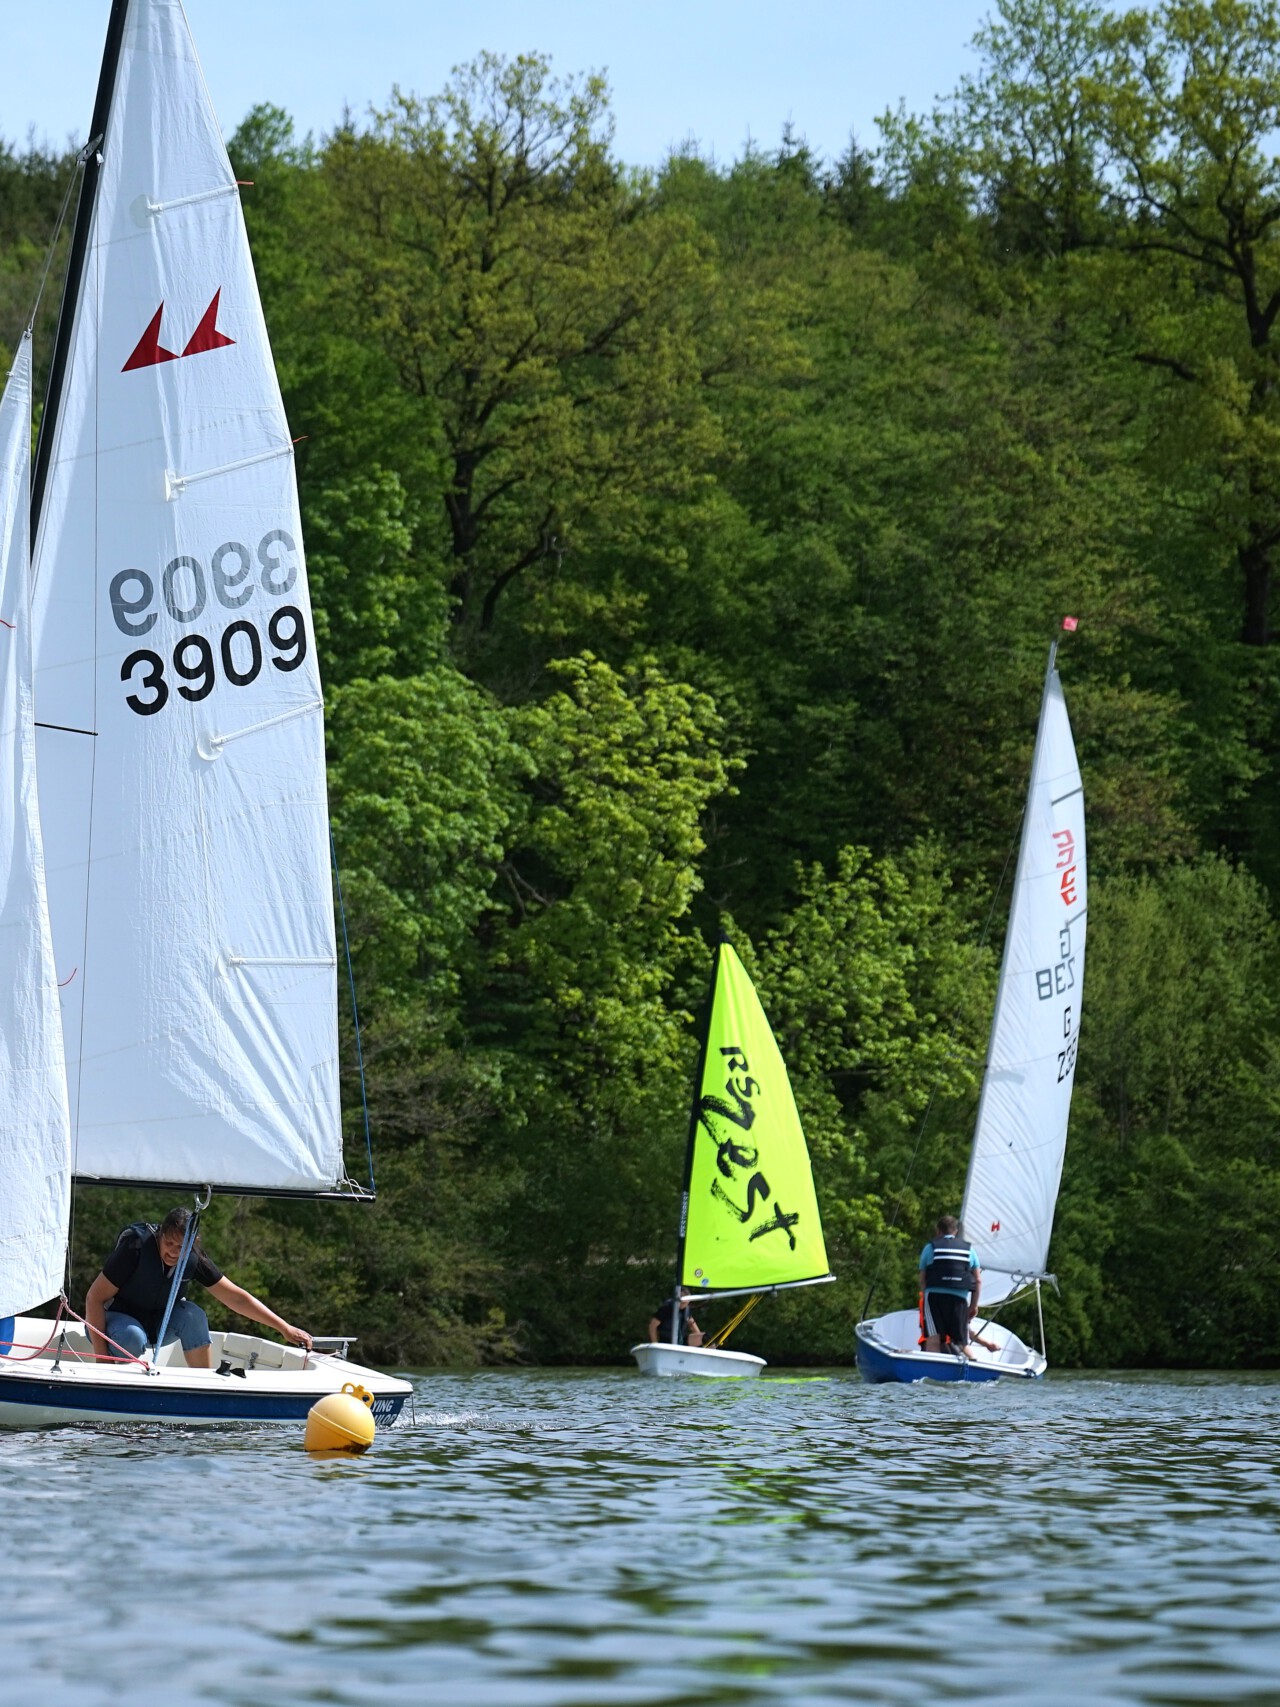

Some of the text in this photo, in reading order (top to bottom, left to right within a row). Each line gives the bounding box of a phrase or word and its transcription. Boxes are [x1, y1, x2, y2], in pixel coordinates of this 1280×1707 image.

[120, 605, 307, 716] 3909
[1064, 1006, 1071, 1038] G
[719, 1046, 761, 1101] RS
[371, 1399, 394, 1413] YING
